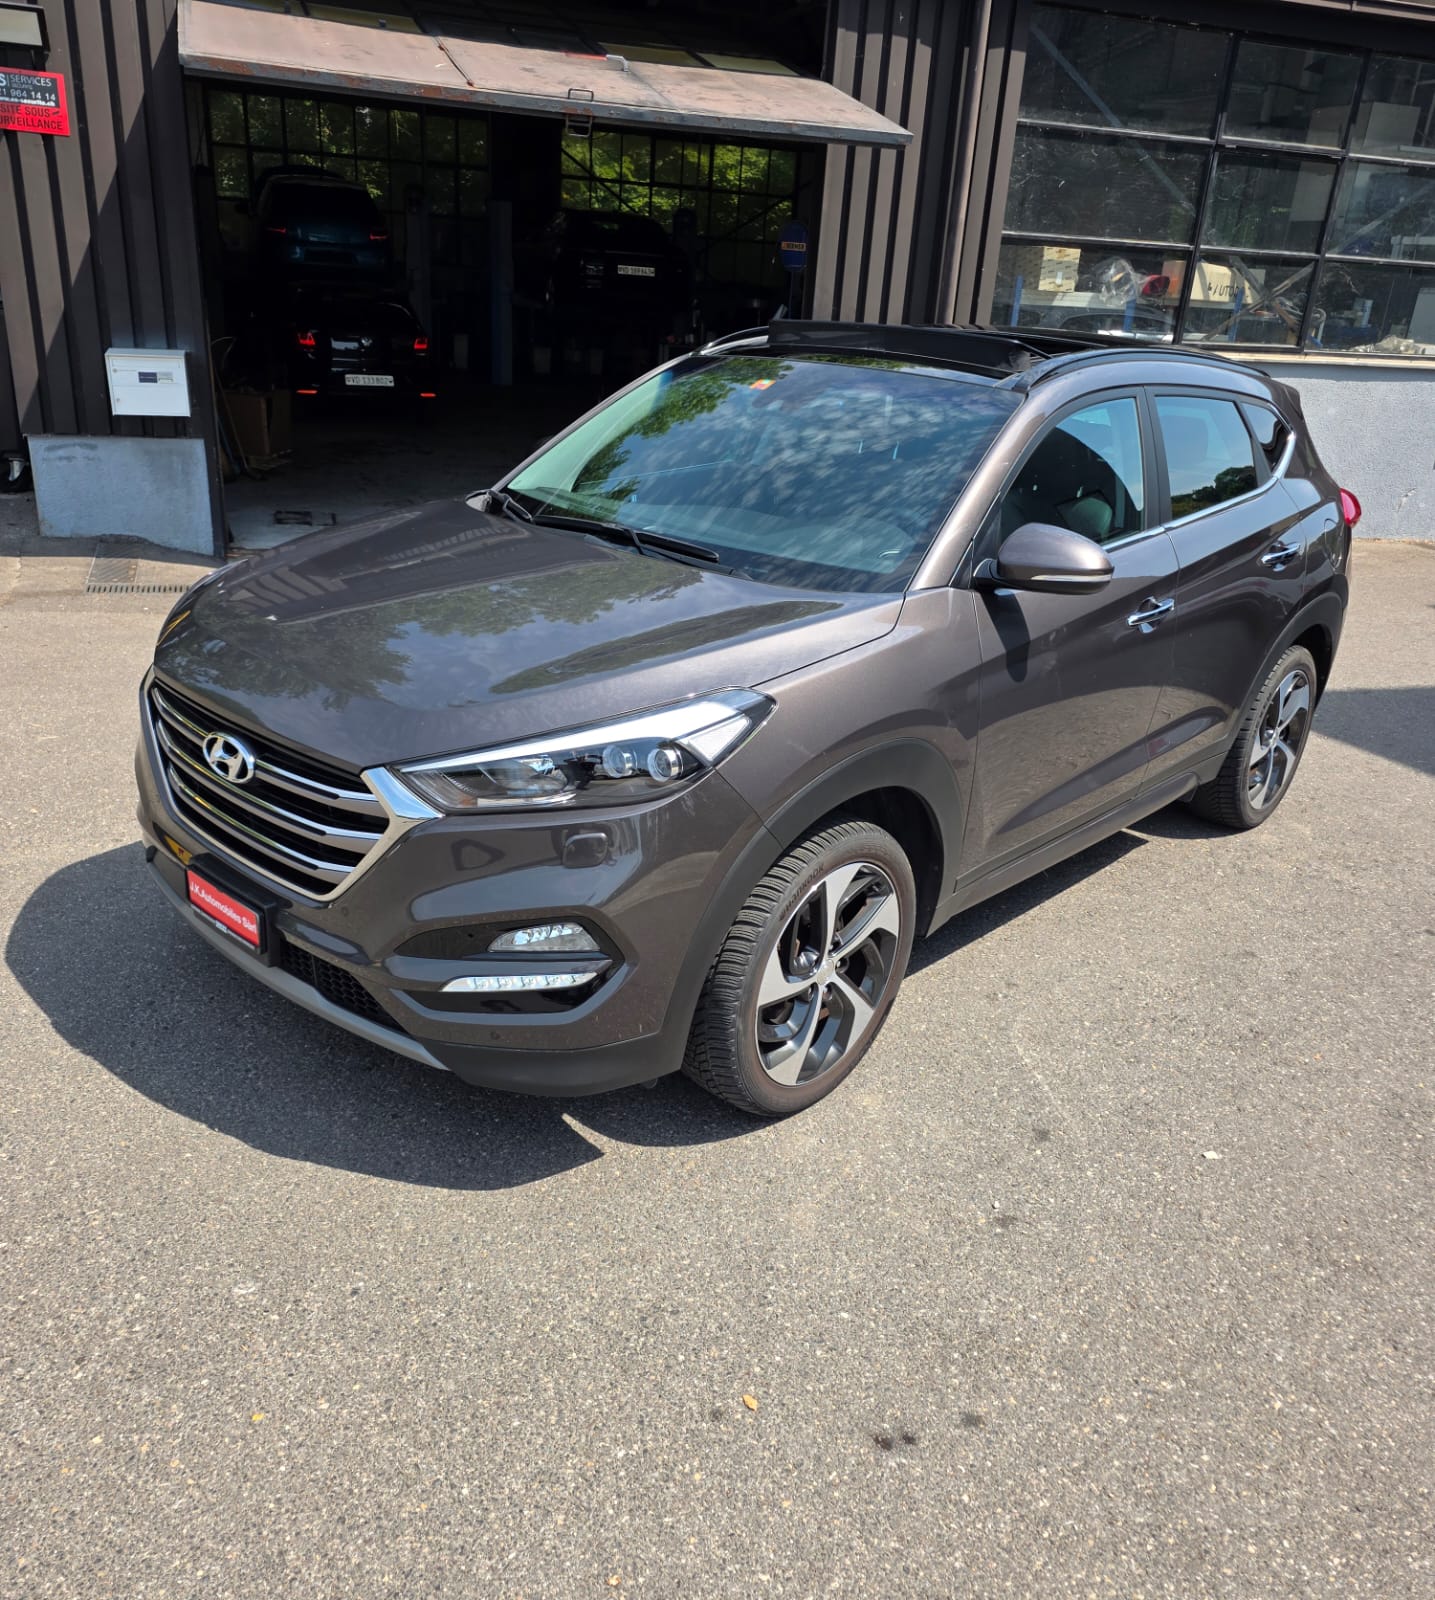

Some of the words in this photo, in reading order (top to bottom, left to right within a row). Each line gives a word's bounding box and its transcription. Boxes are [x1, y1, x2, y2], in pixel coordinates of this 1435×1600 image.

[11, 75, 52, 87] SERVICES
[31, 91, 41, 100] 14
[45, 93, 56, 101] 14
[0, 103, 21, 115] SITE
[25, 106, 50, 118] SOUS
